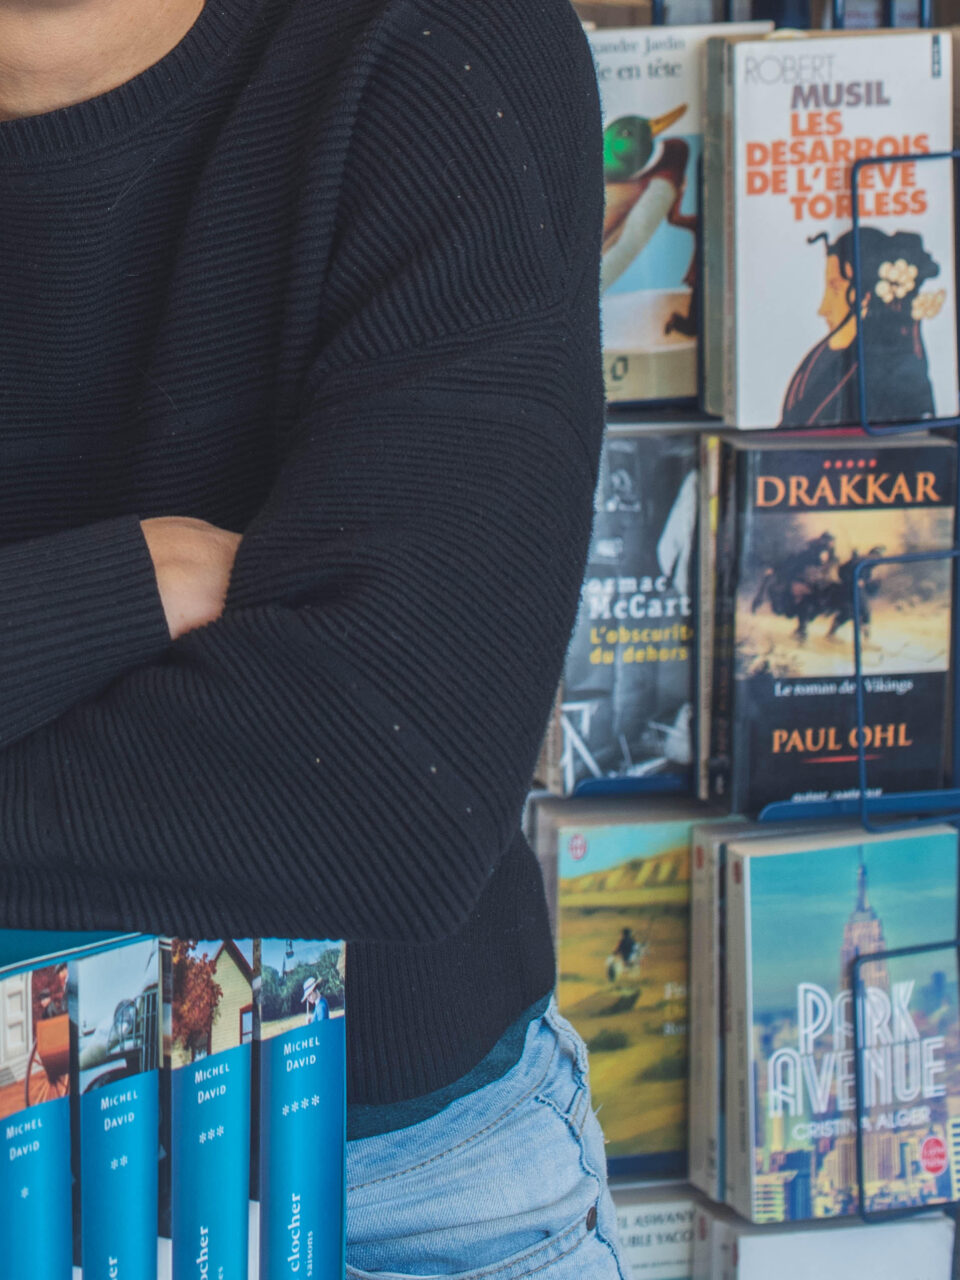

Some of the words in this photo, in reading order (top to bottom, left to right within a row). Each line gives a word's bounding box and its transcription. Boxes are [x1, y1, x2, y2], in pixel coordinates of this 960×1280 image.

[744, 53, 835, 85] ROBERT
[791, 81, 891, 109] MUSIL
[791, 111, 843, 137] LES
[746, 170, 787, 195] DE
[755, 472, 941, 507] DRAKKAR
[589, 646, 614, 664] du
[623, 645, 688, 663] dehors
[774, 682, 792, 697] Le
[794, 683, 836, 695] roman
[839, 680, 862, 694] de
[772, 727, 842, 753] PAUL
[848, 723, 913, 748] OHL
[797, 979, 921, 1055] PARK
[768, 1036, 947, 1117] AVENUE
[287, 1193, 301, 1272] clocher
